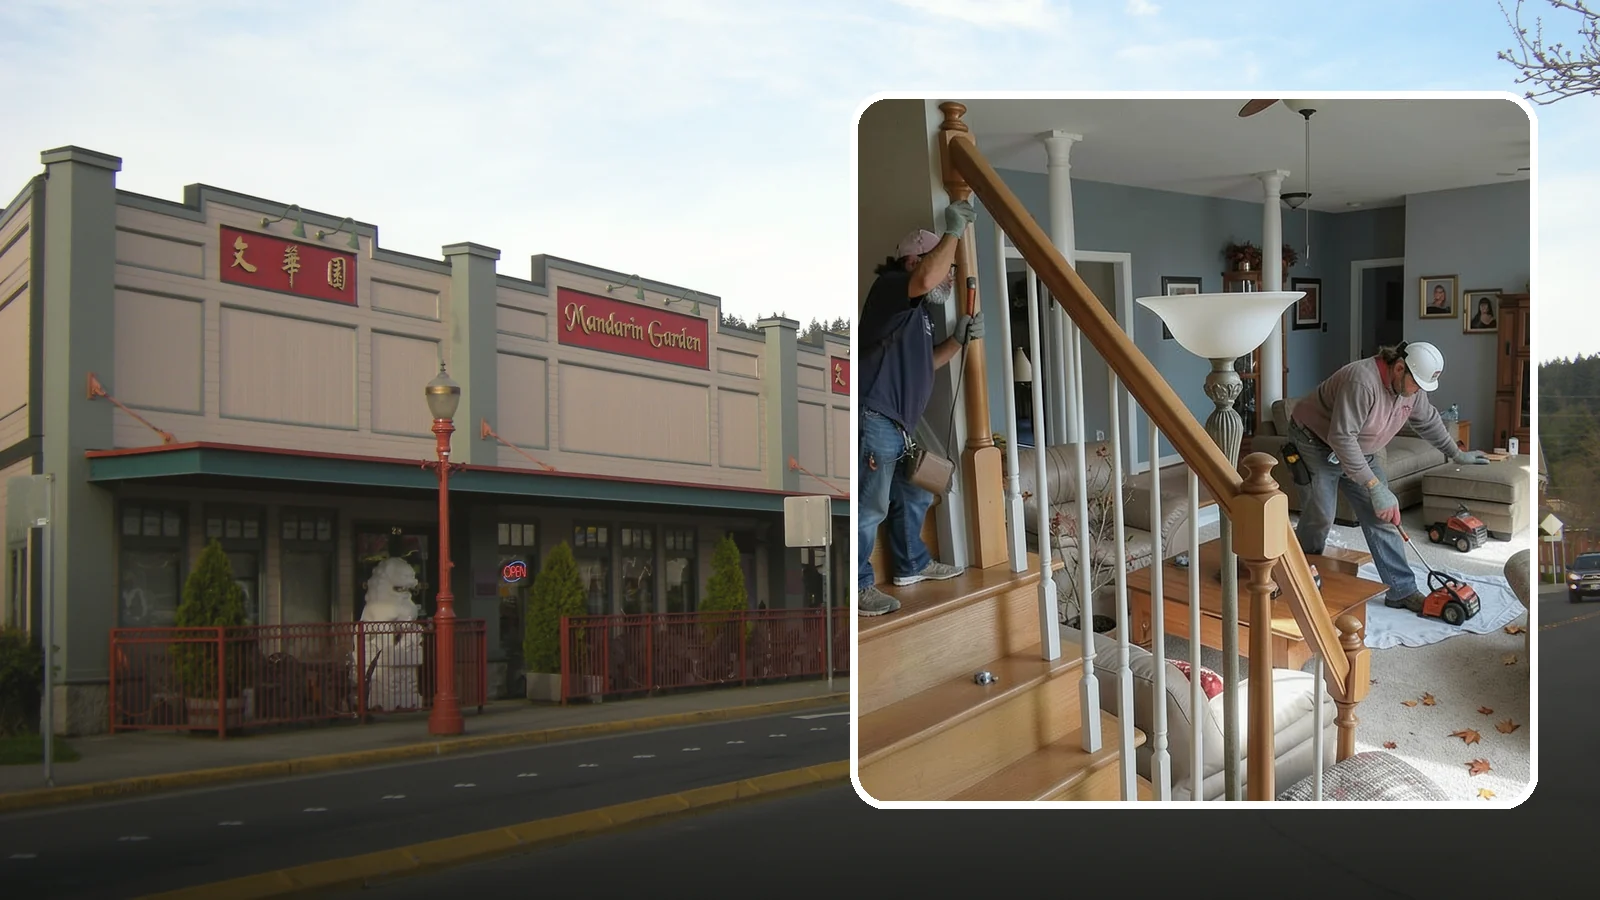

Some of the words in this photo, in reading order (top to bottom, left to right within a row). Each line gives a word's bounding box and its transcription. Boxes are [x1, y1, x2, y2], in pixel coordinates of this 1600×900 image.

[231, 235, 346, 290] 文華園
[564, 302, 644, 341] Mandarin
[648, 320, 701, 352] Garden
[503, 565, 527, 578] OPEN
